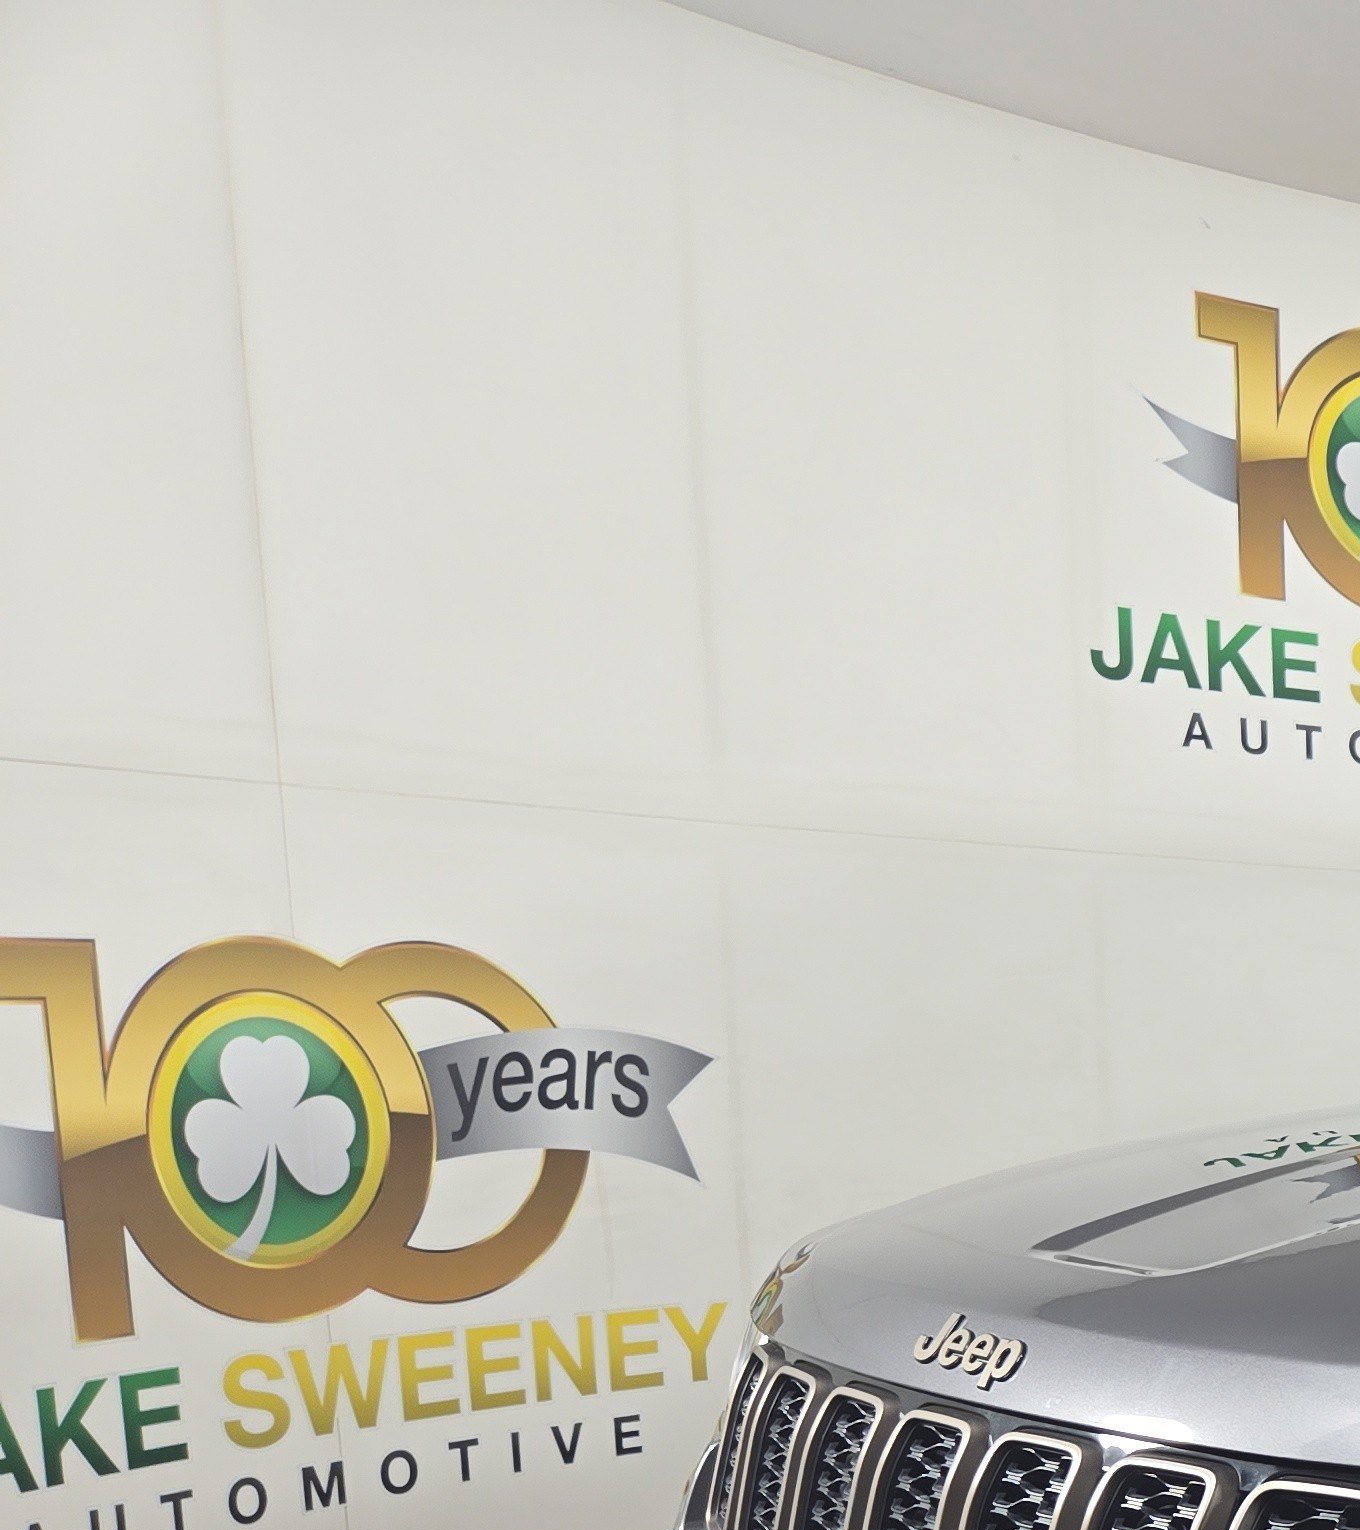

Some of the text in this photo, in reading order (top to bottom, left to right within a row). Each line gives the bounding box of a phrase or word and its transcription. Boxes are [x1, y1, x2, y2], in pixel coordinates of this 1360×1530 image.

[1089, 604, 1322, 704] JAKE
[445, 1046, 652, 1144] years
[221, 1301, 729, 1450] SWEENEY
[914, 1312, 1029, 1392] Jeep
